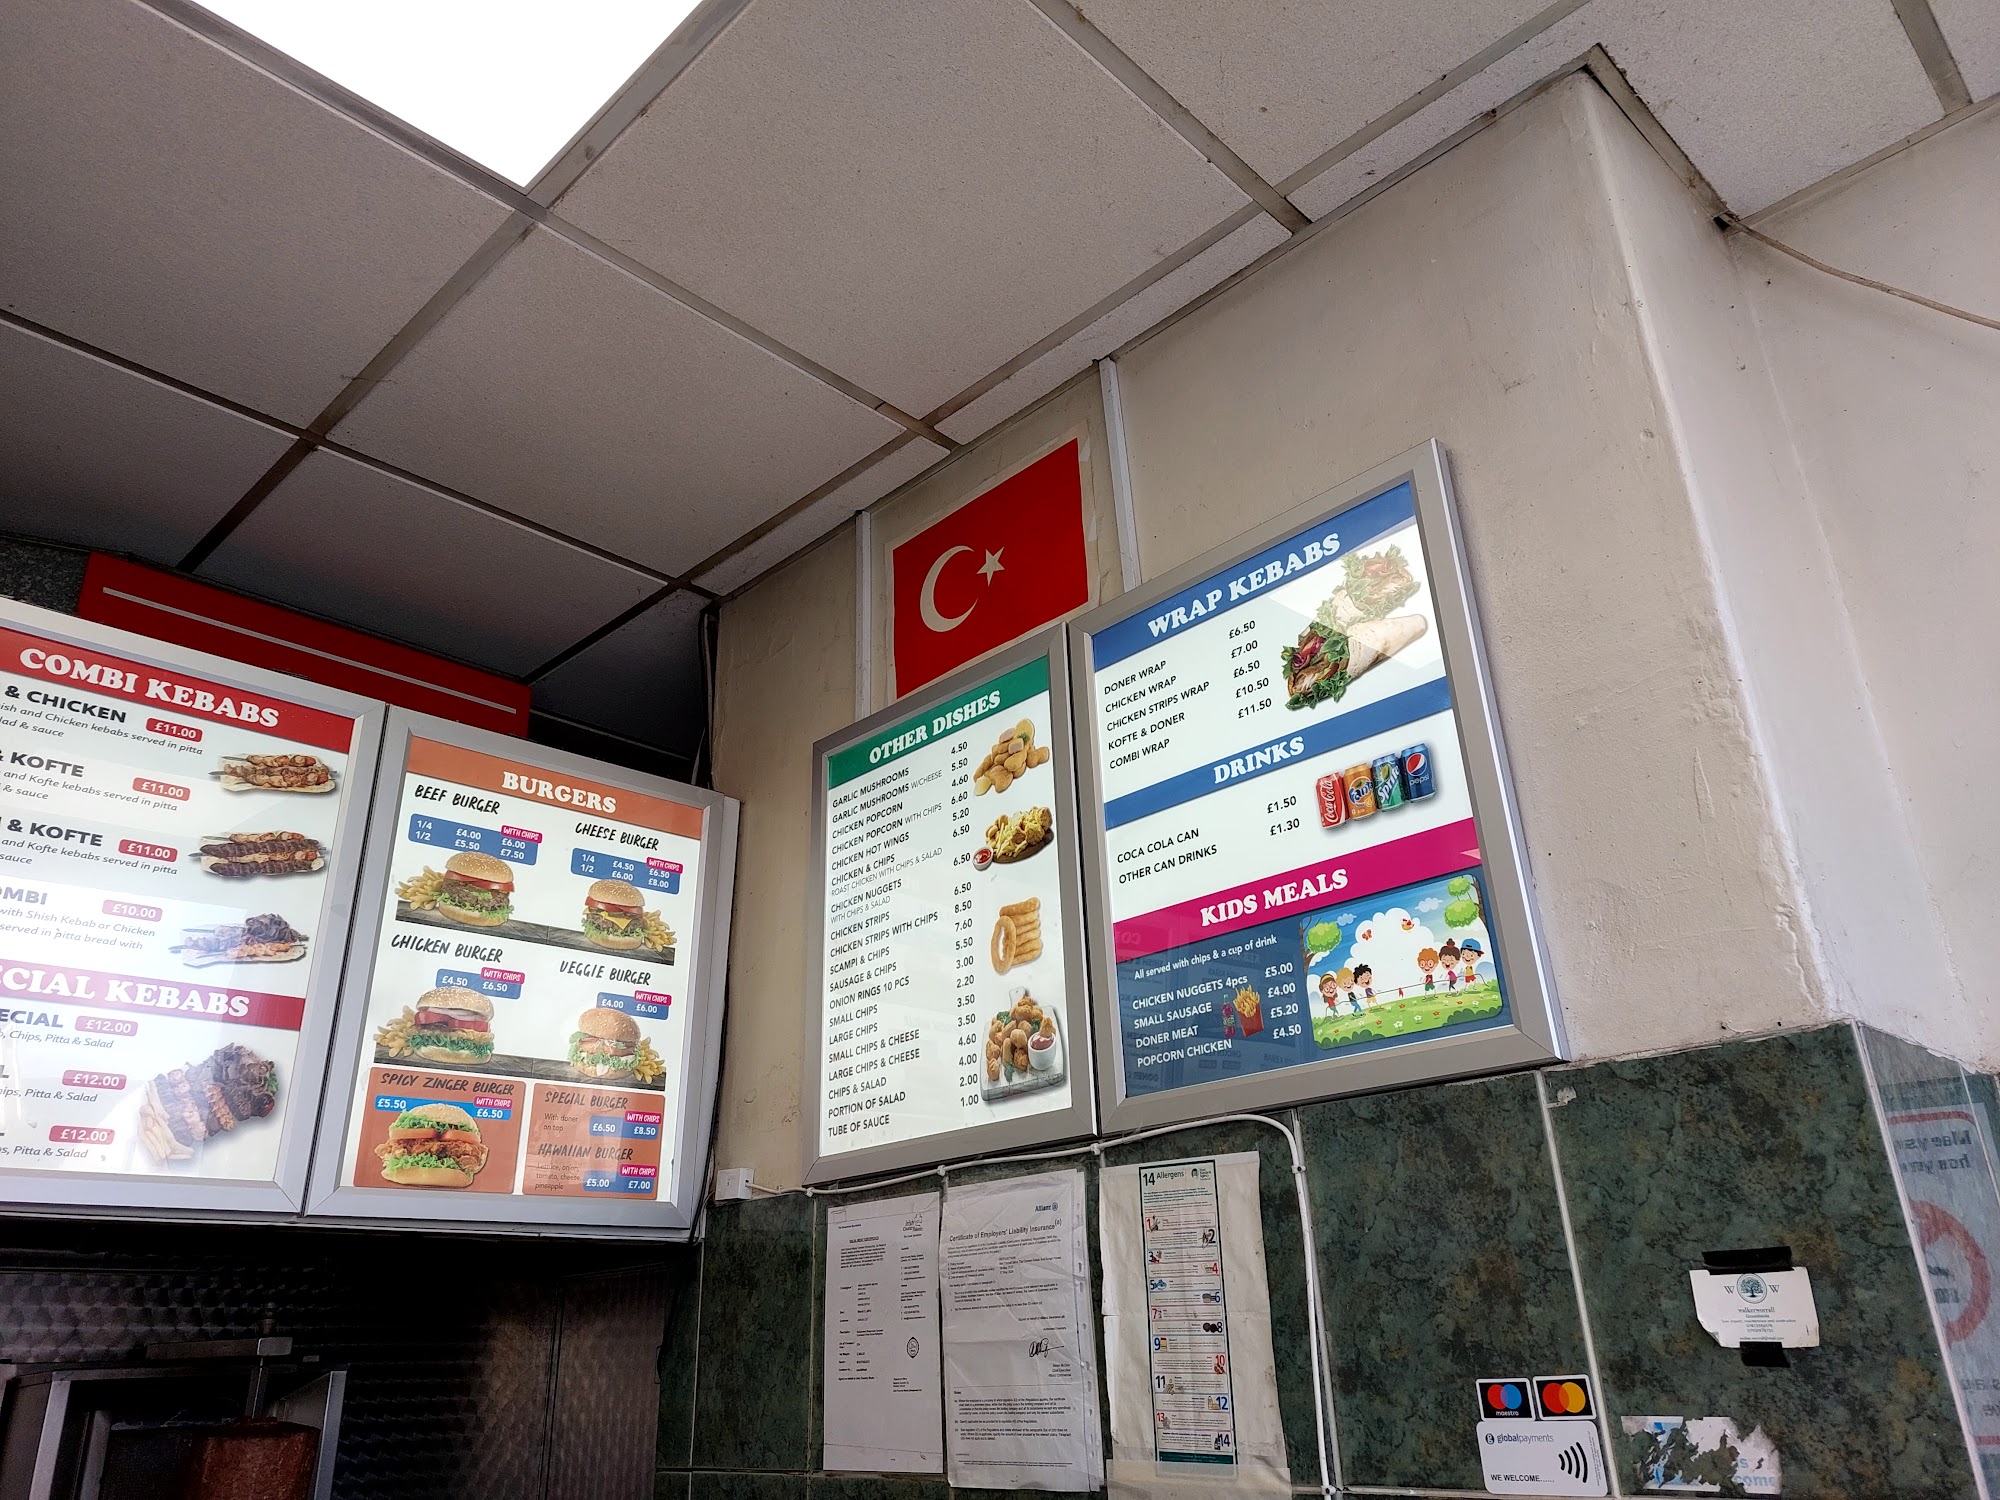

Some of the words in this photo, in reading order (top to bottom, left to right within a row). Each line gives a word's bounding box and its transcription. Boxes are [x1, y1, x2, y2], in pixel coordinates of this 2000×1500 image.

[1147, 589, 1223, 638] WRAP
[1228, 532, 1341, 602] KEBABS
[1104, 673, 1137, 695] DONER
[1138, 660, 1167, 679] WRAP
[1229, 620, 1256, 640] £6.50
[1105, 688, 1146, 713] CHICKEN
[1148, 675, 1177, 694] WRAP
[1230, 639, 1258, 659] £7.00
[19, 648, 139, 694] COMBI
[144, 678, 280, 728] KEBABS
[1106, 707, 1147, 732] CHICKEN
[1148, 694, 1179, 714] STRIPS
[1180, 681, 1210, 700] WRAP
[1233, 659, 1260, 679] £6.50
[19, 709, 44, 719] and
[44, 713, 89, 729] Chicken
[90, 722, 130, 738] kebabs
[131, 734, 167, 746] served
[167, 740, 177, 749] in
[178, 745, 203, 755] pitta
[26, 690, 127, 724] CHICKEN
[155, 722, 197, 740] £11.00
[869, 724, 929, 764] OTHER
[932, 689, 1001, 736] DISHES
[1108, 731, 1138, 751] KOFTE
[1140, 727, 1148, 737] &
[1150, 712, 1185, 734] DONER
[1235, 677, 1269, 699] £10.50
[1109, 750, 1140, 770] COMBI
[1141, 738, 1170, 756] WRAP
[1237, 697, 1272, 719] £11.50
[9, 751, 85, 778] KOFTE
[140, 781, 184, 798] £11.00
[832, 790, 859, 808] GARLIC
[859, 766, 910, 796] MUSHROOMS
[950, 741, 968, 755] 4.50
[1213, 736, 1305, 784] DRINKS
[1409, 775, 1429, 786] pepsi
[414, 784, 448, 802] BEEF
[452, 792, 501, 815] BURGER
[501, 771, 617, 814] BURGERS
[1377, 765, 1400, 803] Sprite
[832, 818, 864, 839] CHICKEN
[866, 801, 903, 825] POPCORN
[951, 773, 969, 787] 4.60
[6, 818, 23, 833] &
[29, 822, 104, 847] KOFTE
[126, 842, 171, 859] £11.00
[415, 830, 431, 841] 1/2
[454, 838, 480, 851] £5.50
[499, 848, 525, 860] £7.50
[417, 820, 433, 830] 1/4
[455, 828, 482, 841] £4.00
[501, 837, 526, 850] £6.00
[503, 826, 522, 837] WITH
[520, 830, 540, 841] CHIPS
[575, 822, 617, 841] CHEESE
[619, 831, 660, 851] BURGER
[831, 850, 864, 871] CHICKEN
[865, 842, 882, 857] HOT
[883, 831, 910, 849] WINGS
[952, 807, 970, 822] 5.20
[1117, 847, 1145, 864] COCA
[1147, 837, 1175, 853] COLA
[1176, 827, 1199, 843] CAN
[1267, 795, 1297, 814] £1.50
[1118, 866, 1152, 884] OTHER
[1153, 857, 1176, 873] CAN
[1178, 844, 1217, 865] DRINKS
[1269, 817, 1300, 836] £1.30
[830, 893, 864, 914] CHICKEN
[865, 878, 902, 901] NUGGETS
[953, 852, 971, 867] 6.50
[1200, 894, 1258, 927] KIDS
[1262, 868, 1349, 910] MEALS
[391, 933, 451, 954] CHICKEN
[454, 943, 503, 963] BURGER
[1134, 968, 1145, 980] All
[1145, 961, 1171, 977] served
[1171, 957, 1190, 970] with
[1190, 953, 1212, 965] chips
[1212, 949, 1220, 960] &
[1220, 949, 1227, 958] a
[1227, 945, 1243, 956] cup
[1244, 939, 1254, 951] of
[1254, 933, 1278, 949] drink
[559, 960, 605, 979] VEGGIE
[609, 967, 651, 986] BURGER
[829, 992, 856, 1010] ONION
[857, 984, 881, 1001] RINGS
[883, 981, 893, 992] 10
[894, 975, 910, 989] PCS
[955, 955, 974, 970] 3.00
[1132, 991, 1175, 1010] CHICKEN
[1176, 978, 1224, 1000] NUGGETS
[1225, 975, 1248, 989] 4pcs
[1264, 961, 1294, 979] £5.00
[104, 979, 250, 1018] KEBABS
[1133, 1013, 1166, 1030] SMALL
[1166, 1001, 1213, 1022] SAUSAGE
[1267, 982, 1296, 999] £4.00
[828, 1048, 854, 1064] SMALL
[855, 1040, 878, 1056] CHIPS
[880, 1038, 886, 1049] &
[888, 1028, 920, 1047] CHEESE
[957, 1013, 976, 1028] 3.50
[1135, 1031, 1170, 1049] DONER
[1171, 1024, 1199, 1041] MEAT
[1270, 1002, 1299, 1019] £5.20
[1137, 1048, 1185, 1068] POPCORN
[1186, 1038, 1233, 1057] CHICKEN
[1272, 1023, 1302, 1040] £4.50
[72, 1074, 120, 1087] £12.00
[380, 1072, 420, 1087] SPICY
[422, 1077, 469, 1092] ZINGER
[472, 1081, 515, 1096] BURGER
[592, 1122, 616, 1133] £6.50
[633, 1125, 656, 1136] £8.50
[827, 1123, 848, 1137] TUBE
[849, 1120, 861, 1133] OF
[863, 1114, 890, 1130] SAUCE
[960, 1093, 979, 1108] 1.00
[13, 1145, 41, 1156] Pitta
[42, 1147, 54, 1157] &
[55, 1148, 89, 1158] Salad
[537, 1142, 592, 1158] HAWAIIAN
[594, 1146, 634, 1162] BURGER
[1142, 1172, 1156, 1186] 14
[1156, 1171, 1185, 1179] Allergens
[949, 1234, 973, 1242] Certificate
[974, 1231, 980, 1239] of
[1008, 1226, 1028, 1235] Liability
[1208, 1228, 1216, 1244] 2
[1149, 1279, 1155, 1290] 5
[1723, 1285, 1735, 1294] W
[1768, 1284, 1780, 1293] W
[1152, 1308, 1158, 1319] 7
[1154, 1337, 1161, 1351] 9
[1215, 1354, 1226, 1366] 10
[1155, 1375, 1166, 1388] 11
[1215, 1396, 1229, 1410] 12
[1220, 1433, 1231, 1447] 14
[1497, 1433, 1554, 1444] globalpayments
